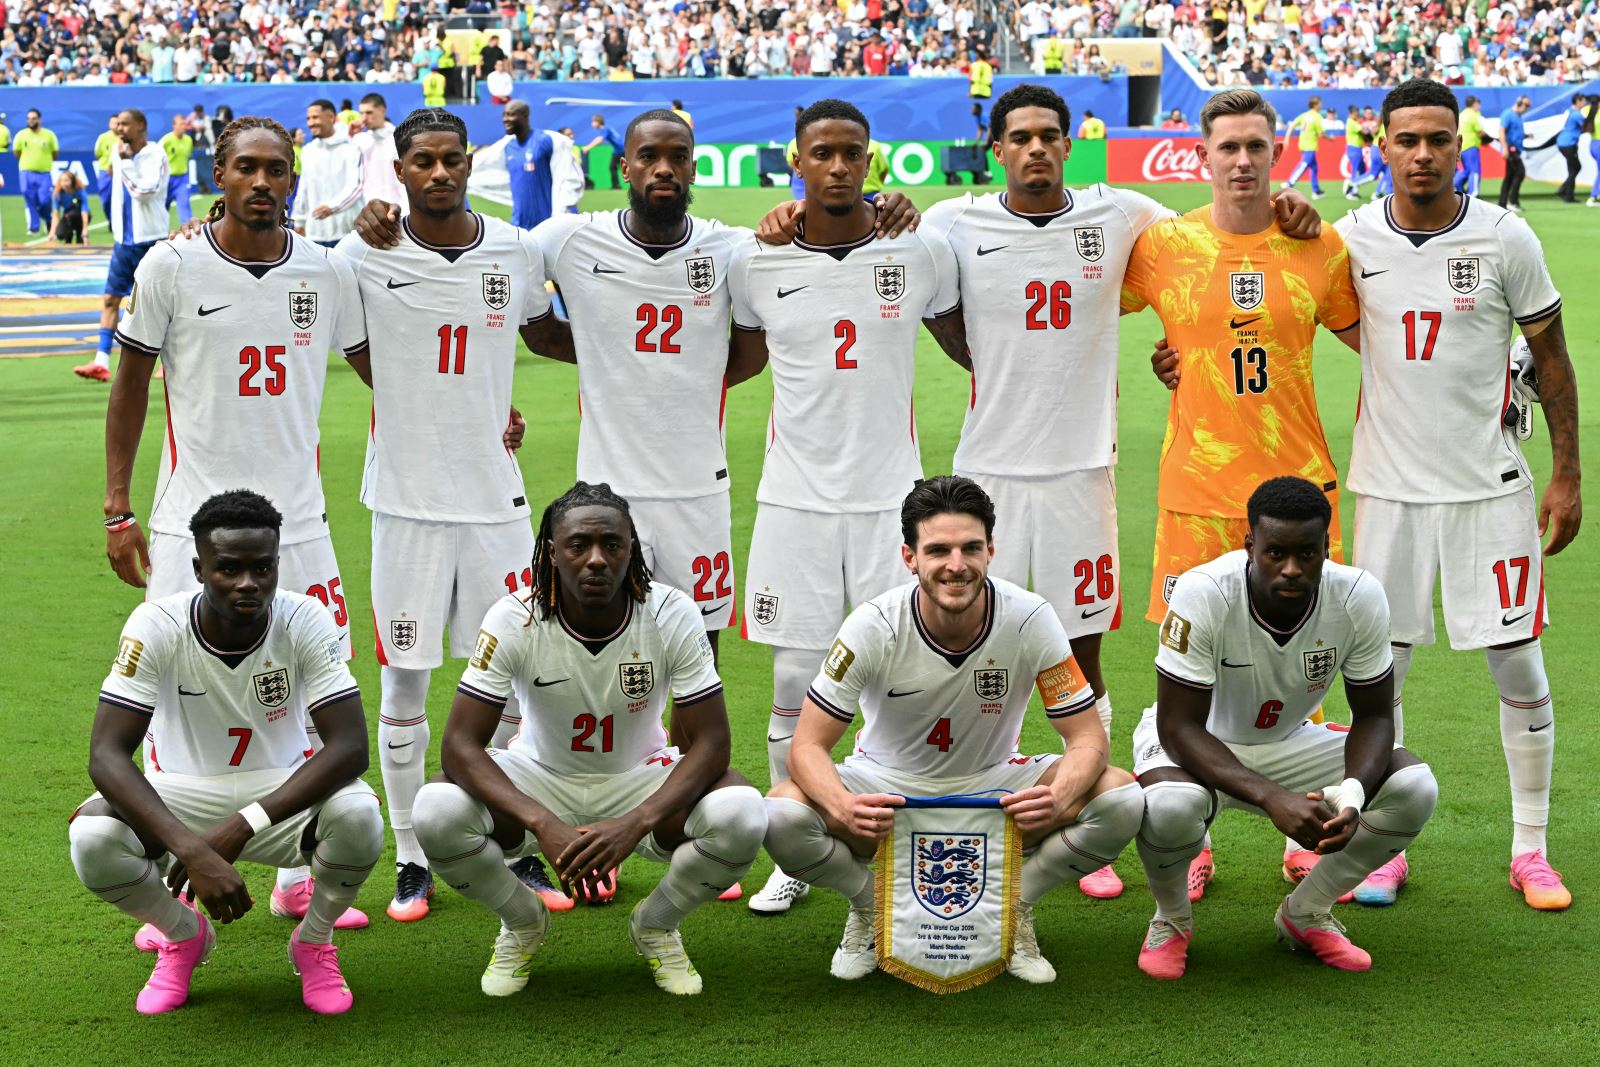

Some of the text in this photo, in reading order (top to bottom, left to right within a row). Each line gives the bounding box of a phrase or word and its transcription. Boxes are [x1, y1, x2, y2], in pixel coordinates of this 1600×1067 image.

[636, 303, 682, 354] 22
[1025, 281, 1071, 330] 26
[437, 324, 468, 374] 11
[834, 319, 857, 369] 2
[1402, 311, 1441, 360] 17
[239, 345, 286, 396] 25
[1230, 346, 1268, 396] 13
[1520, 404, 1529, 434] reusch
[692, 551, 731, 602] 22
[1074, 553, 1113, 605] 26
[1492, 556, 1529, 609] 17
[1041, 672, 1072, 688] UNITES
[1056, 692, 1070, 700] FIFA
[266, 706, 288, 718] FRANCE
[571, 712, 614, 753] 21
[926, 717, 953, 752] 4
[1254, 699, 1284, 729] 6
[228, 727, 252, 766] 7
